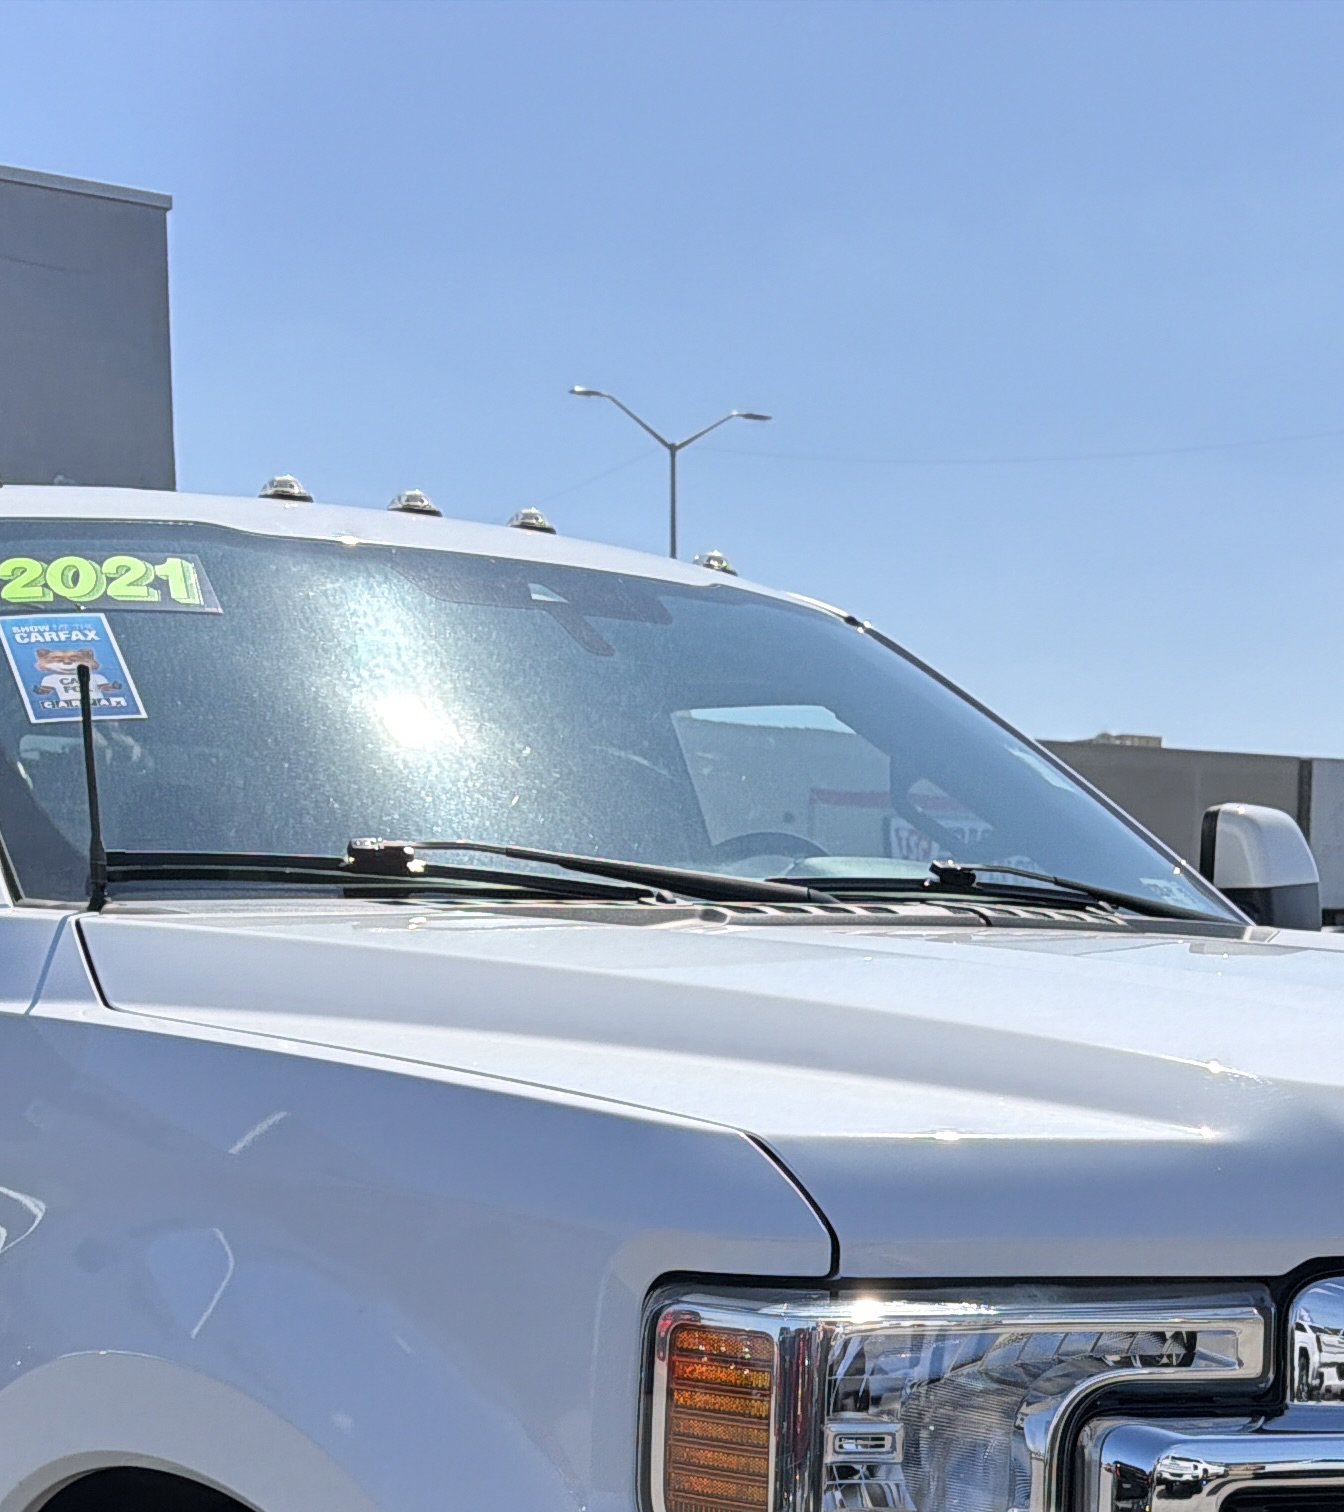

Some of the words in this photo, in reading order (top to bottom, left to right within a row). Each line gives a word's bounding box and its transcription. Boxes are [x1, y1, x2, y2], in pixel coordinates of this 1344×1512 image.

[11, 624, 50, 634] SHOW
[14, 630, 101, 644] CARFAX
[41, 697, 128, 709] CARAX
